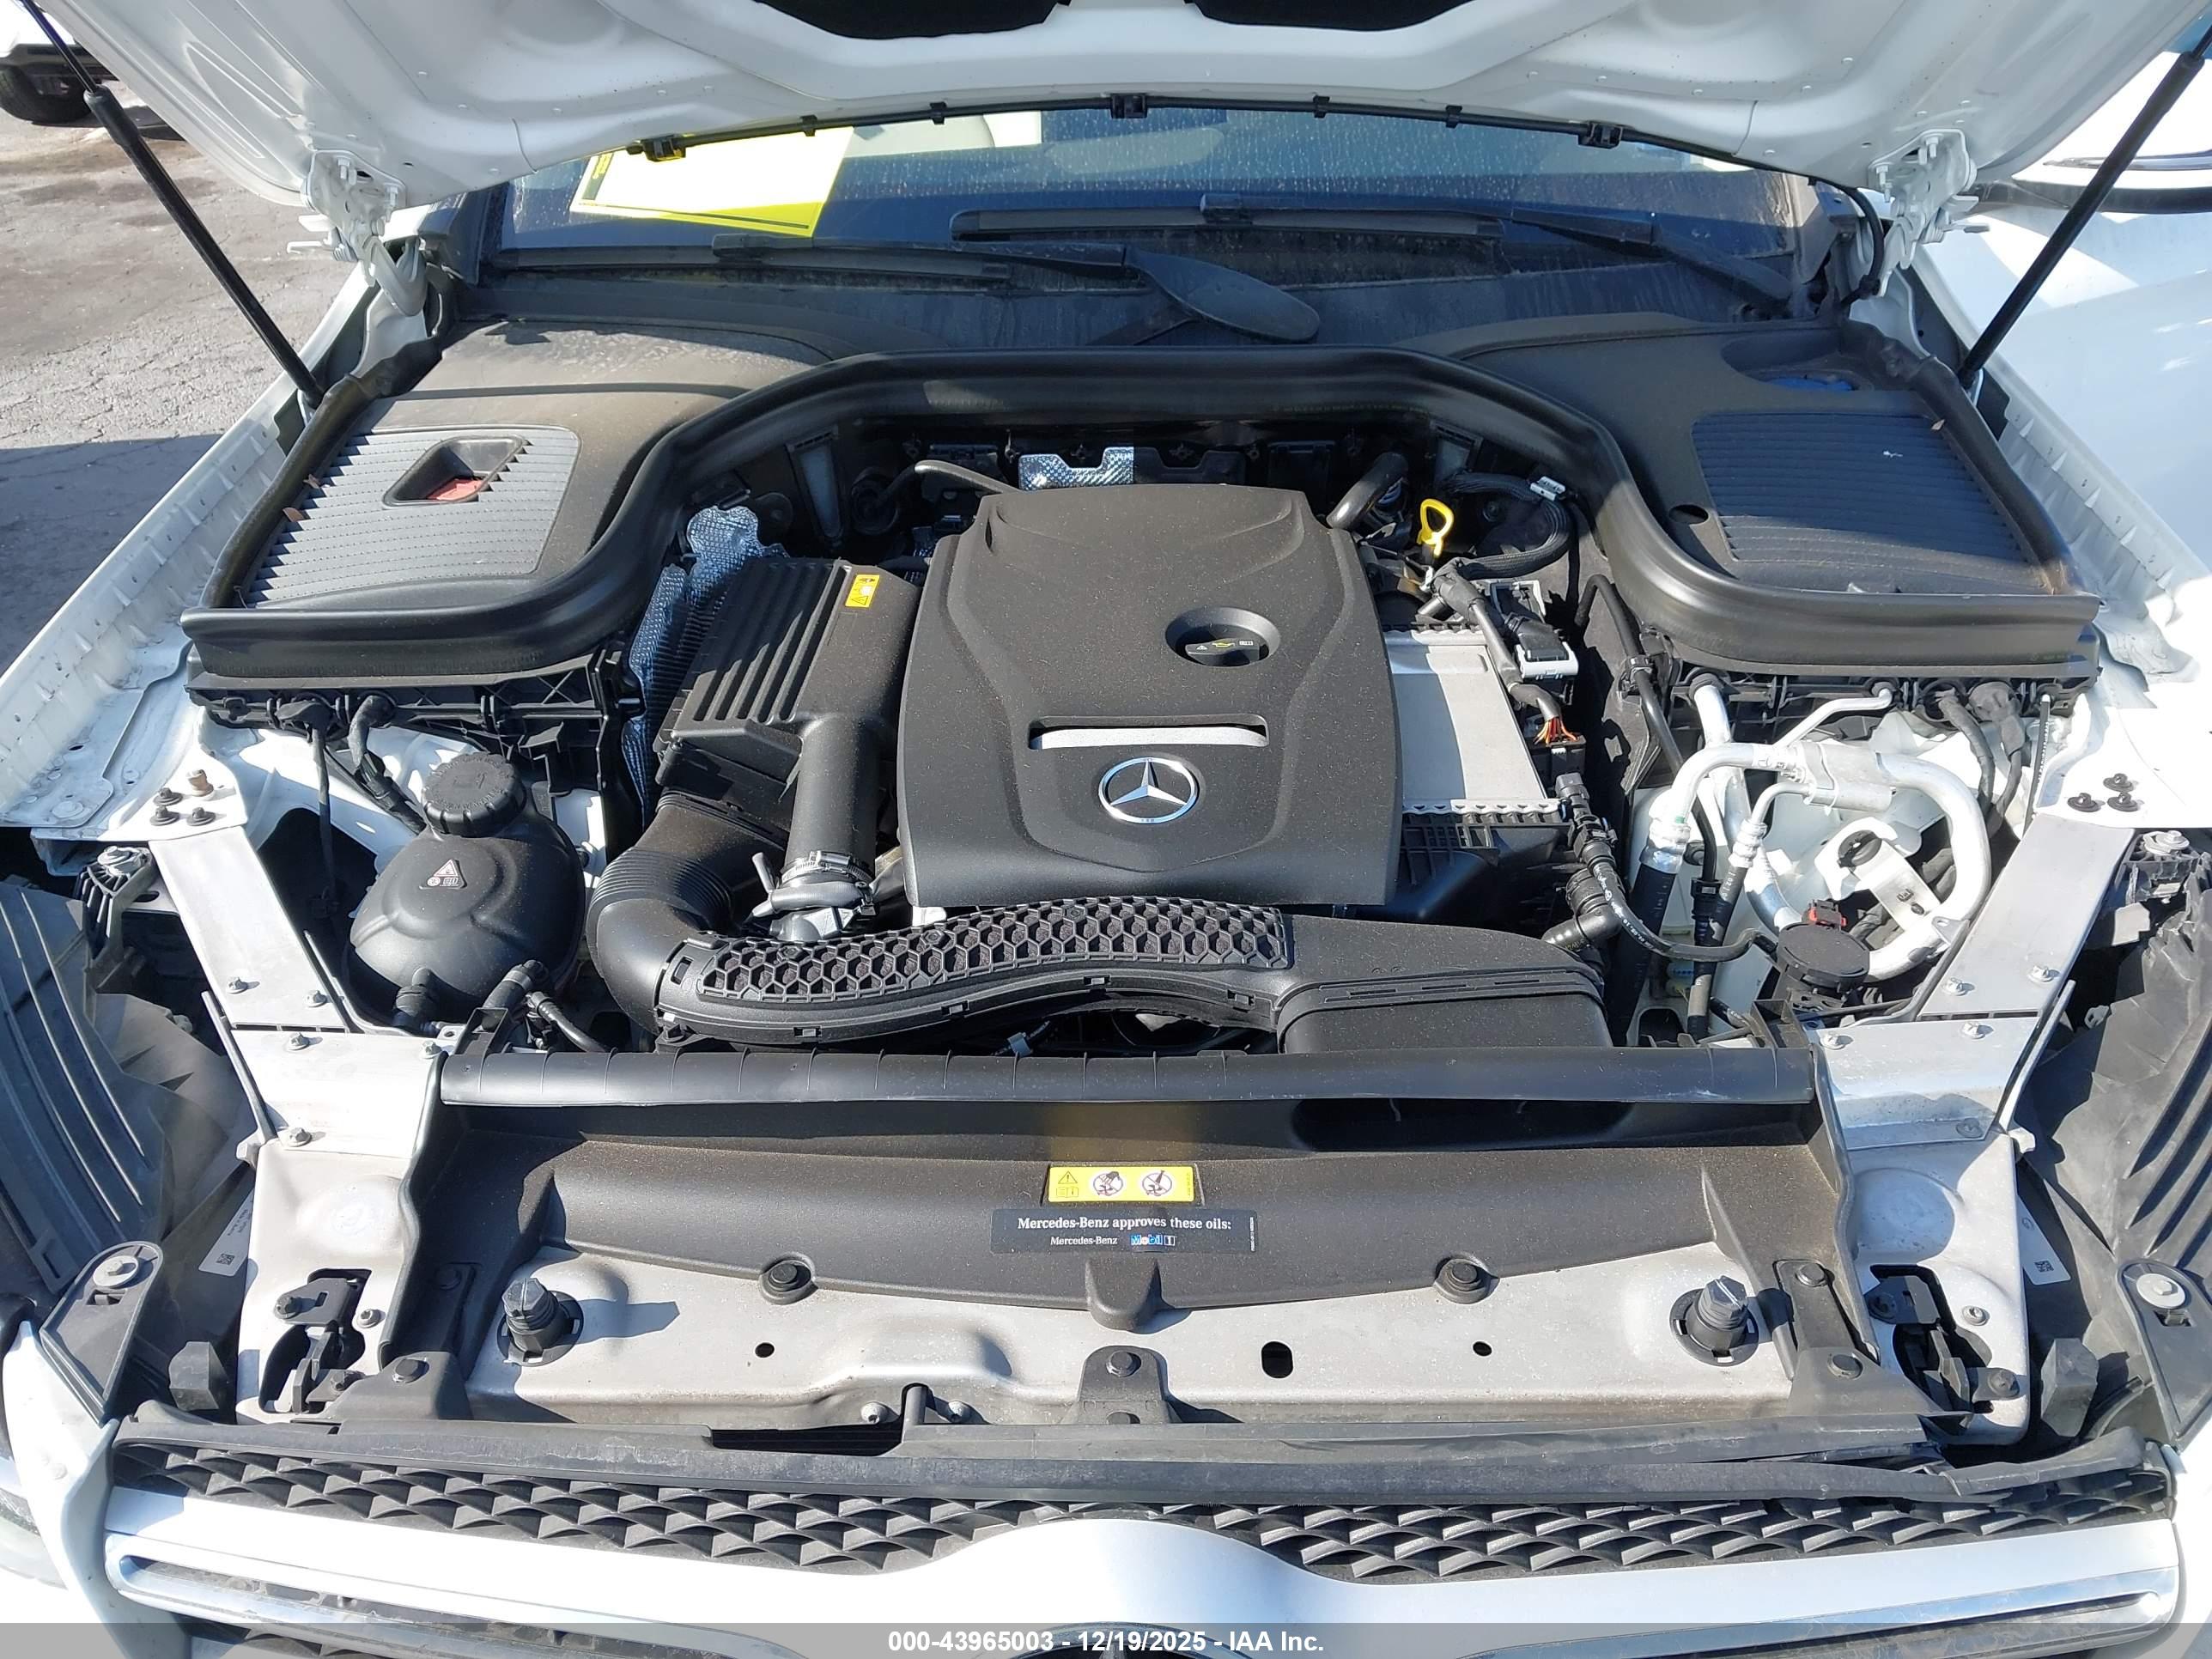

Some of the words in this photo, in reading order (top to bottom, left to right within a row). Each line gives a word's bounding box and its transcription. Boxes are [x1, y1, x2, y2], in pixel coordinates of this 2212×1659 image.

[1017, 1216, 1109, 1230] Mercedes-Benz
[1112, 1217, 1167, 1231] approves
[1170, 1217, 1203, 1229] these
[1205, 1217, 1231, 1230] oils:
[1050, 1235, 1118, 1246] Mercedes-Benz
[1131, 1234, 1163, 1246] Mobil
